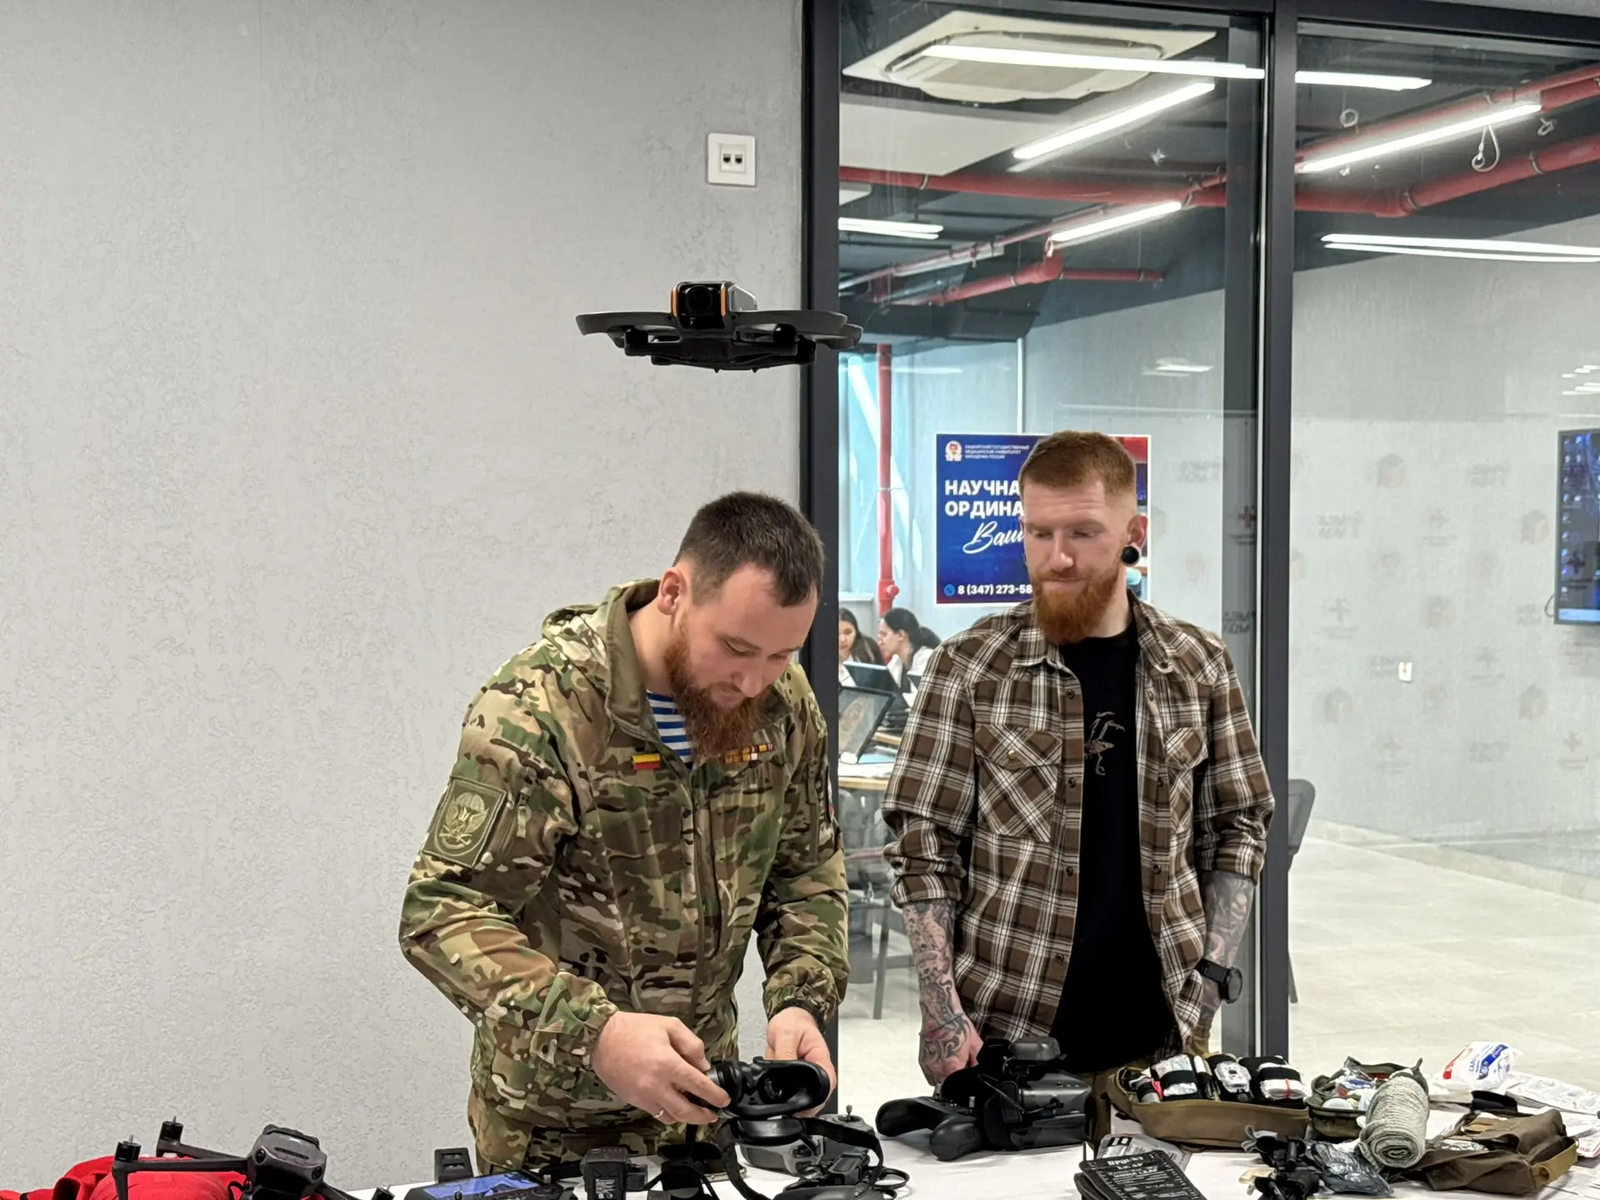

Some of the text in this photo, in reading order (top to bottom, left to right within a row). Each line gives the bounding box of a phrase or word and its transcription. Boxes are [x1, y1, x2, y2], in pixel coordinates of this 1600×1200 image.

[945, 479, 1020, 496] НАУЧНА
[944, 500, 1025, 519] ОРДИНА
[957, 583, 1033, 595] 8 (347) 273-58
